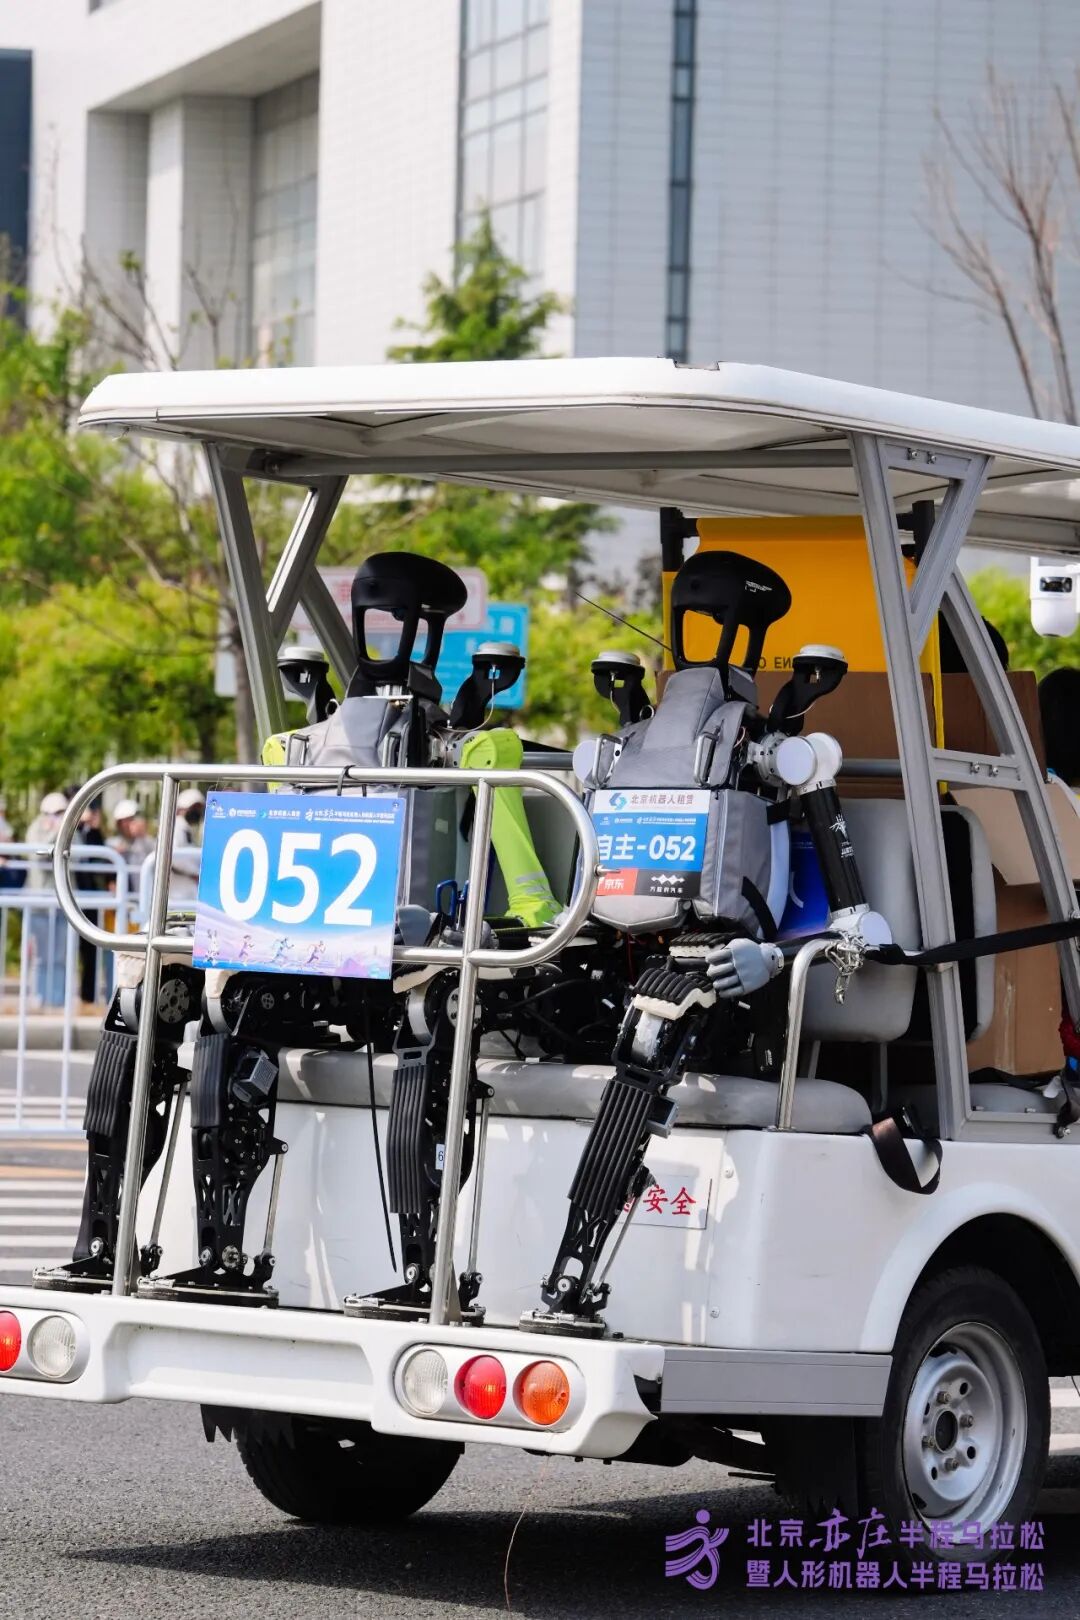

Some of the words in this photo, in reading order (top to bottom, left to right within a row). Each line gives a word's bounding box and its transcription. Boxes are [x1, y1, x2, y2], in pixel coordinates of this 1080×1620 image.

[631, 794, 694, 805] 北京机器人租赁
[597, 833, 697, 861] 自主-052
[219, 828, 378, 927] 052
[604, 878, 625, 889] 京东
